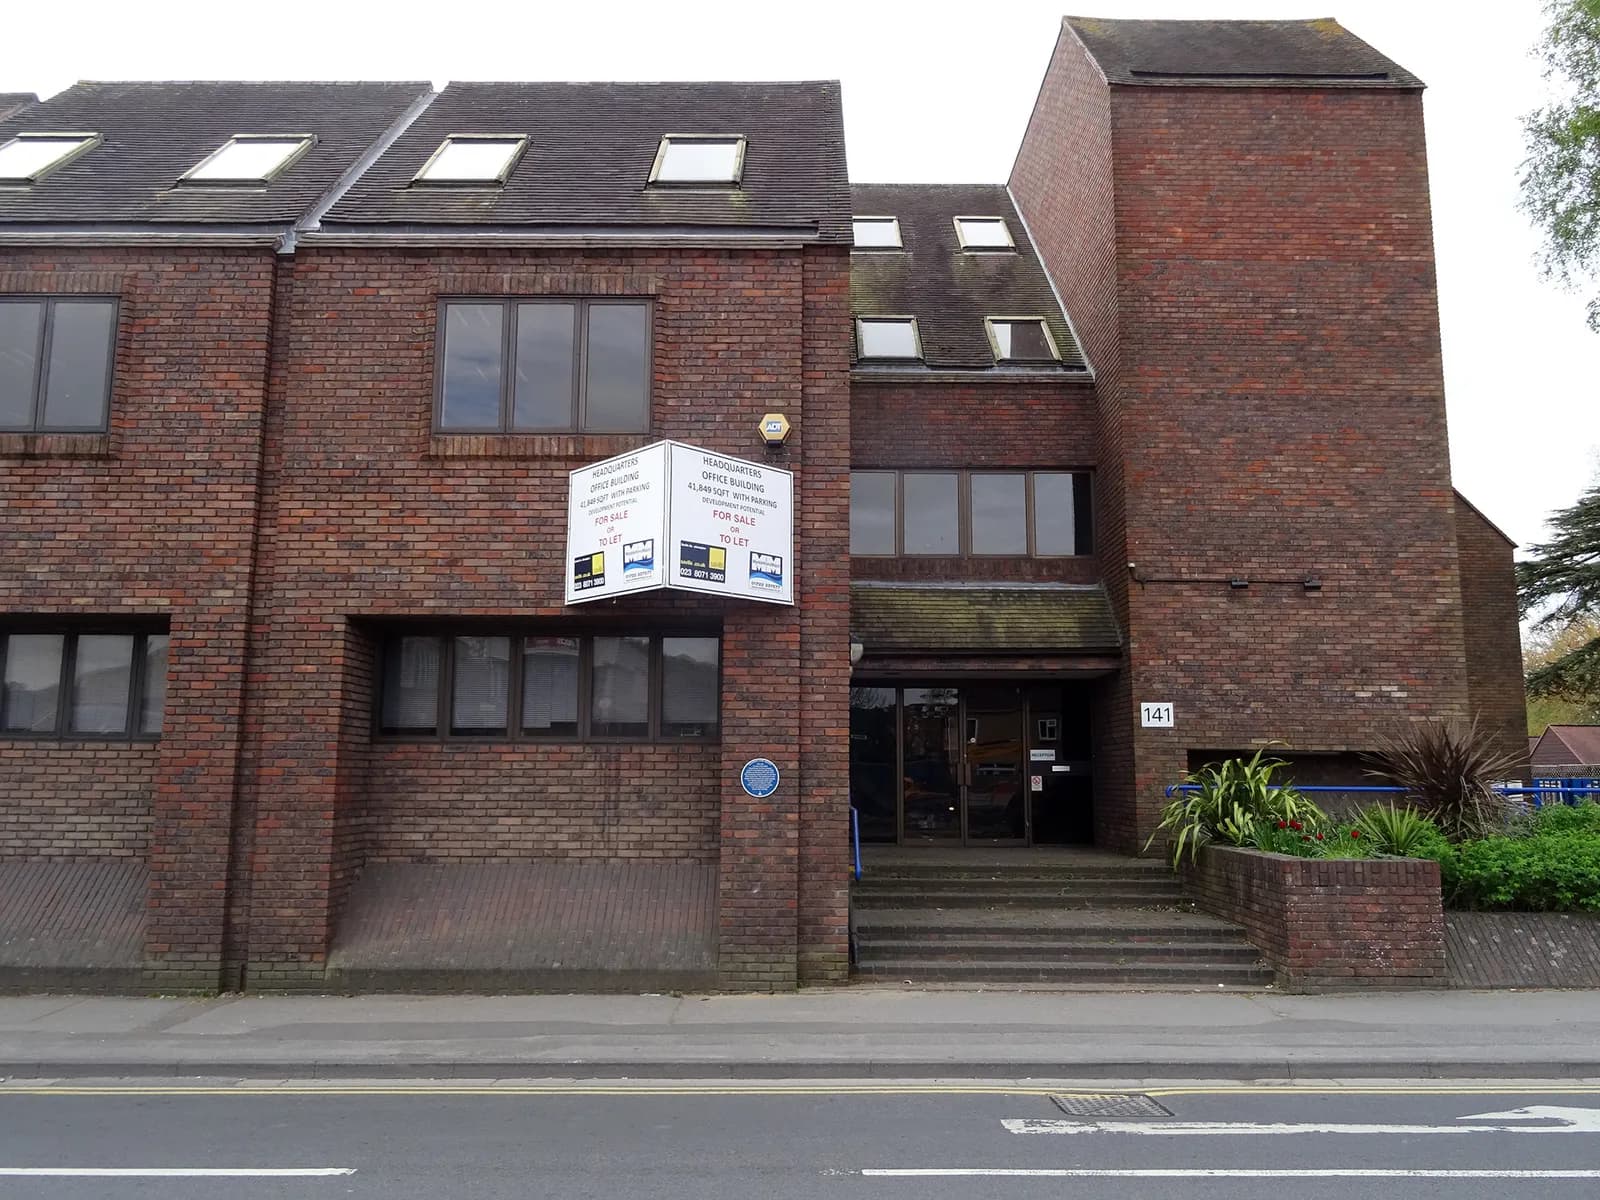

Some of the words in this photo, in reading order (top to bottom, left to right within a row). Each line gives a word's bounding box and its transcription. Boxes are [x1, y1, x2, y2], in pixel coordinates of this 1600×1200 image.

[766, 423, 783, 431] ADT
[592, 457, 639, 478] HEADQUARTERS
[703, 457, 762, 479] HEADQUARTERS
[590, 480, 609, 493] OFFICE
[610, 471, 640, 487] BUILDING
[702, 471, 728, 485] OFFICE
[729, 477, 765, 493] BUILDING
[610, 489, 626, 499] WITH
[626, 482, 650, 493] PARKING
[688, 482, 712, 494] 41,849
[713, 487, 730, 498] SQFT
[732, 492, 750, 502] WITH
[750, 496, 777, 509] PARKING
[702, 497, 740, 510] DEVELOPMENT
[740, 505, 765, 516] POTENTIAL
[595, 515, 609, 525] FOR
[610, 510, 629, 522] SALE
[713, 510, 732, 520] FOR
[733, 514, 756, 525] SALE
[599, 538, 608, 547] TO
[609, 534, 622, 545] LET
[720, 534, 731, 544] TO
[733, 538, 749, 547] LET
[680, 567, 692, 577] 023
[694, 569, 709, 579] 8071
[709, 572, 725, 581] 3900
[1144, 707, 1171, 723] 141
